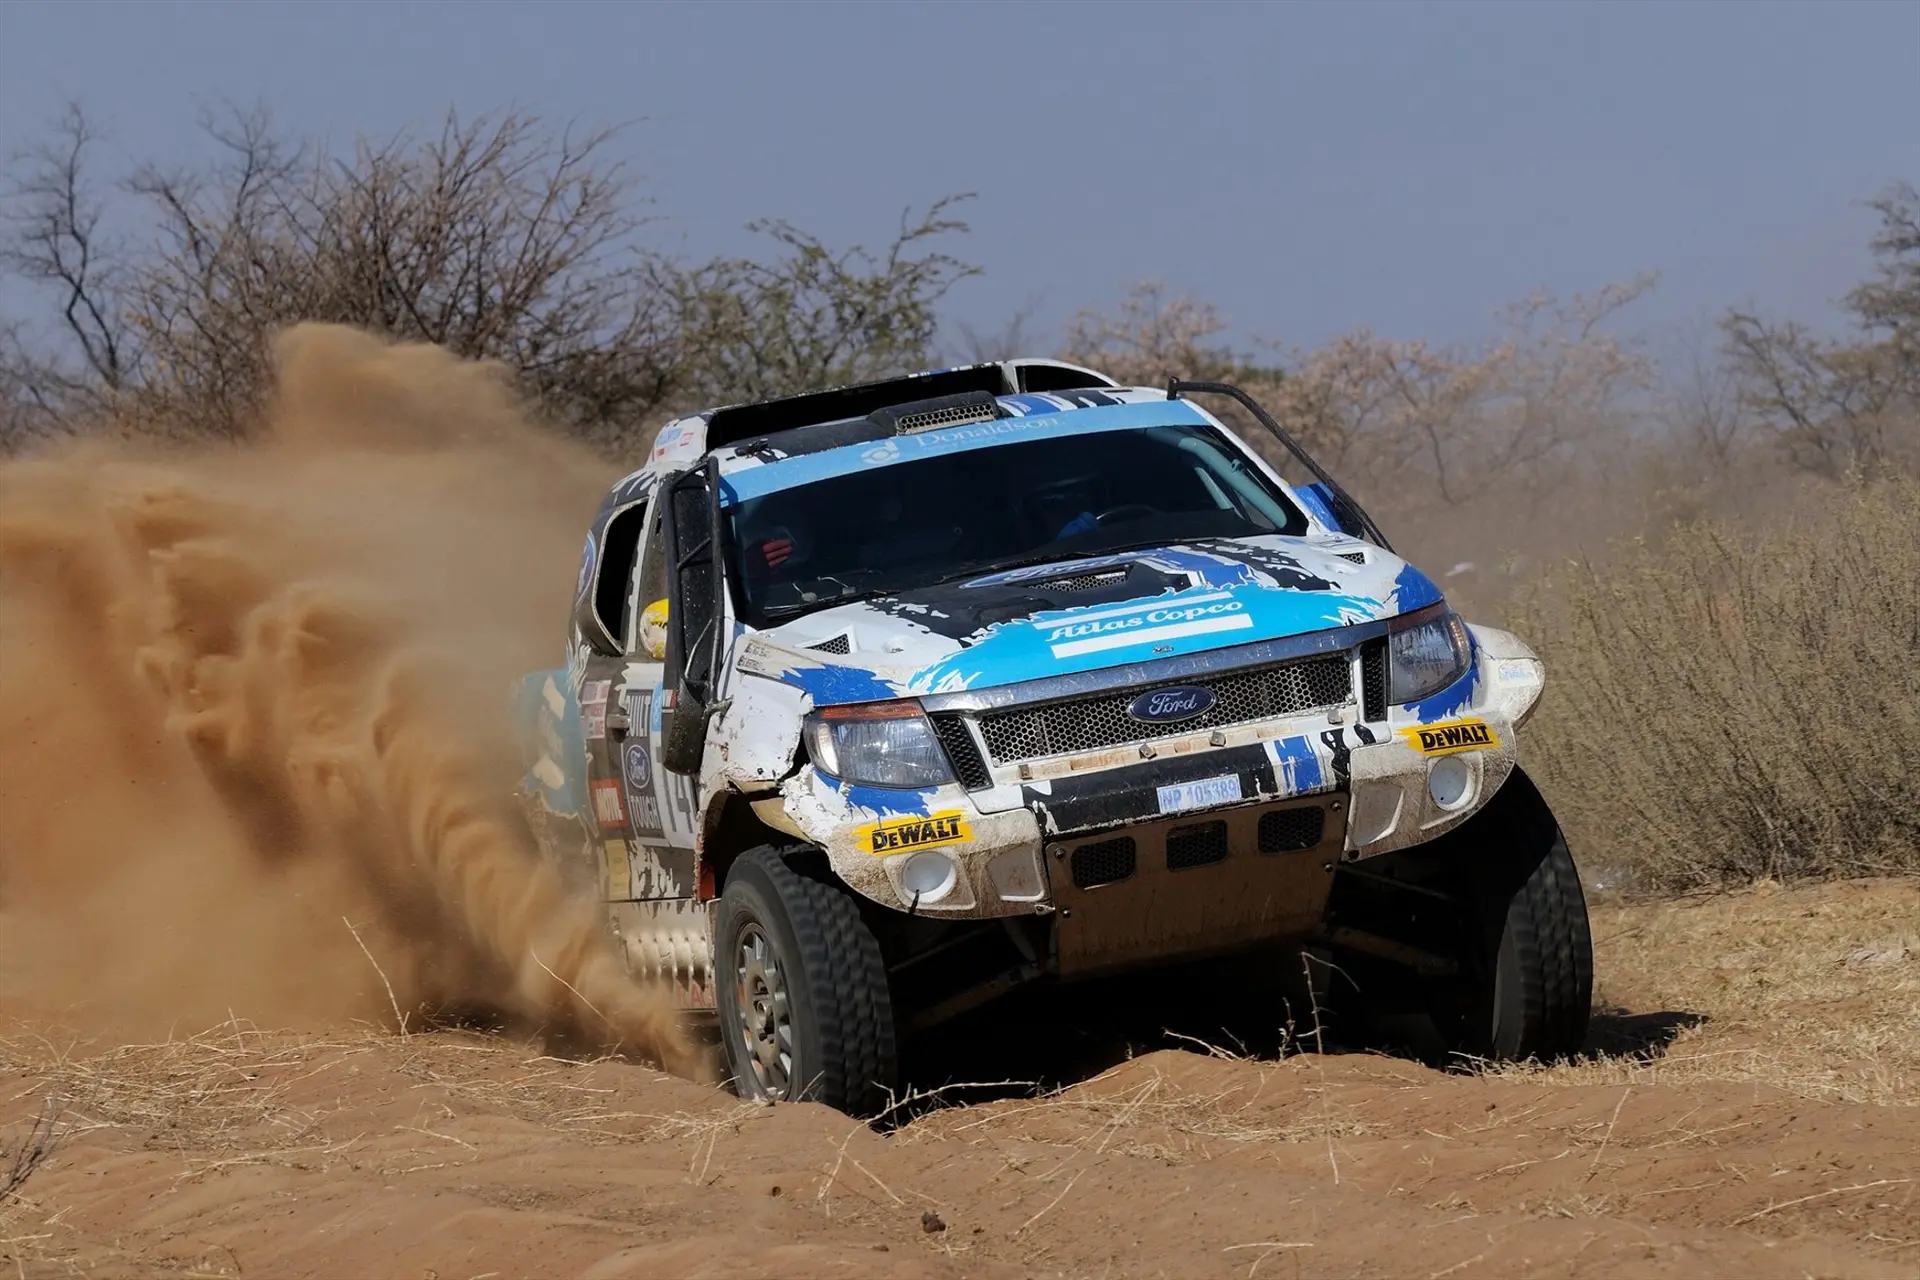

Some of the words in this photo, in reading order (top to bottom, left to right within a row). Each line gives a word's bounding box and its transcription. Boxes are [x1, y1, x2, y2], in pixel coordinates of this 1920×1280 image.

[914, 416, 1058, 448] Donaldson
[1045, 617, 1143, 642] Atlas
[1146, 601, 1243, 624] Copco
[1149, 690, 1197, 716] Ford
[1418, 725, 1490, 748] DEWALT
[630, 795, 662, 830] TOUGH
[872, 818, 961, 850] DEWALT
